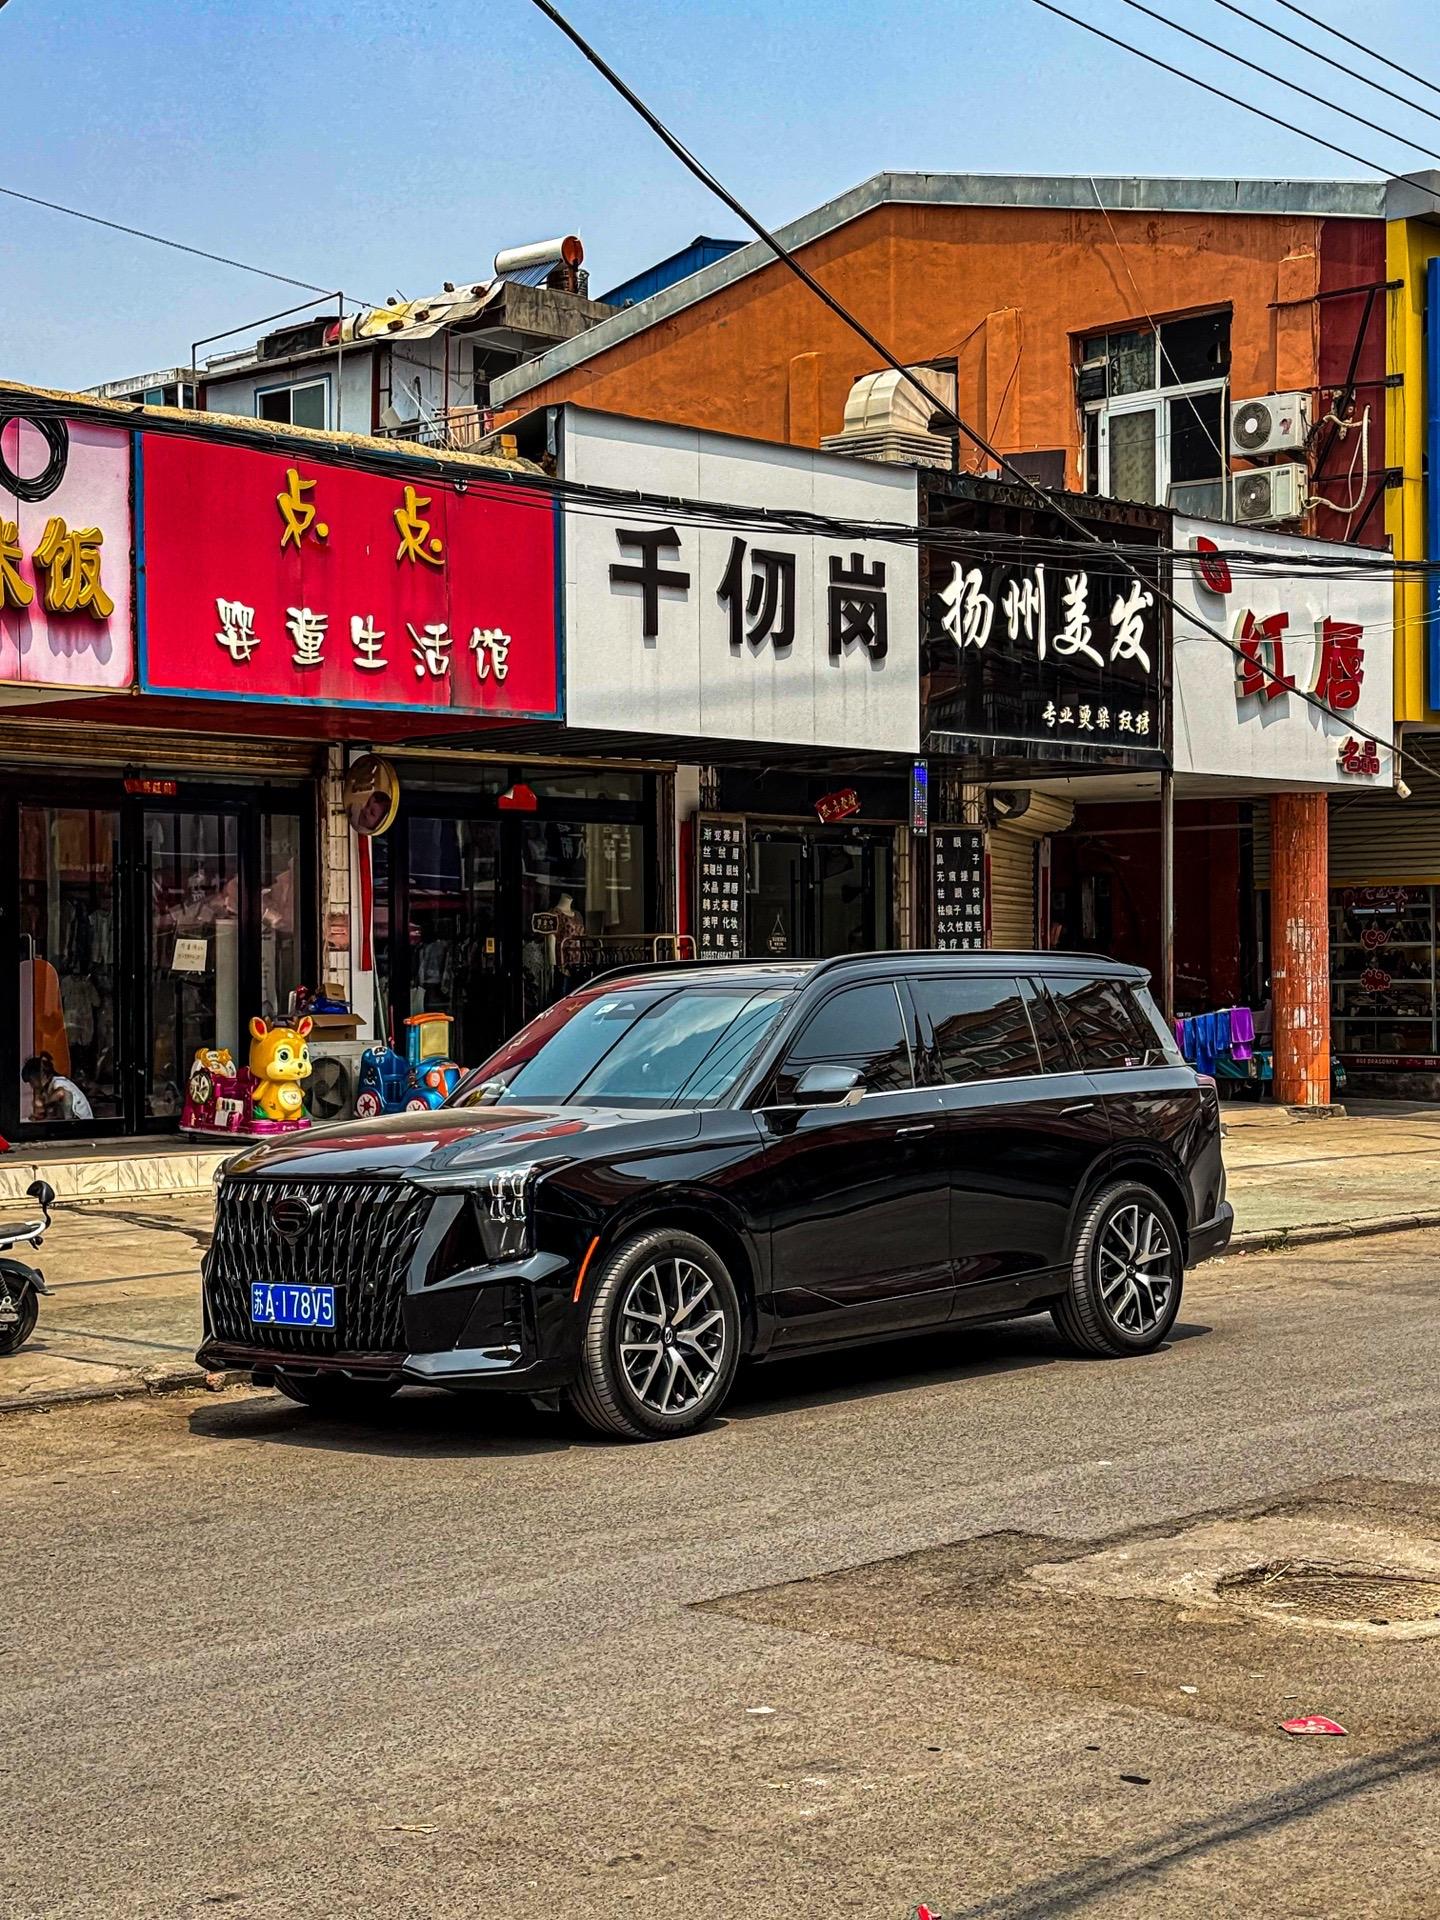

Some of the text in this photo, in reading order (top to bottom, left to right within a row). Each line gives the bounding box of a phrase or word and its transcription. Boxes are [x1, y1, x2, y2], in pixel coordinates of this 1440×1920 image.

[277, 468, 445, 564] 点点
[609, 526, 888, 659] 千仞岗
[937, 561, 1153, 674] 扬州美发
[215, 598, 512, 680] 婴童生活馆
[1336, 736, 1380, 775] 名品
[935, 836, 979, 848] 双眼皮
[702, 881, 719, 894] 水晶
[702, 916, 738, 930] 美甲 化妆
[937, 921, 982, 933] 永久性脱毛
